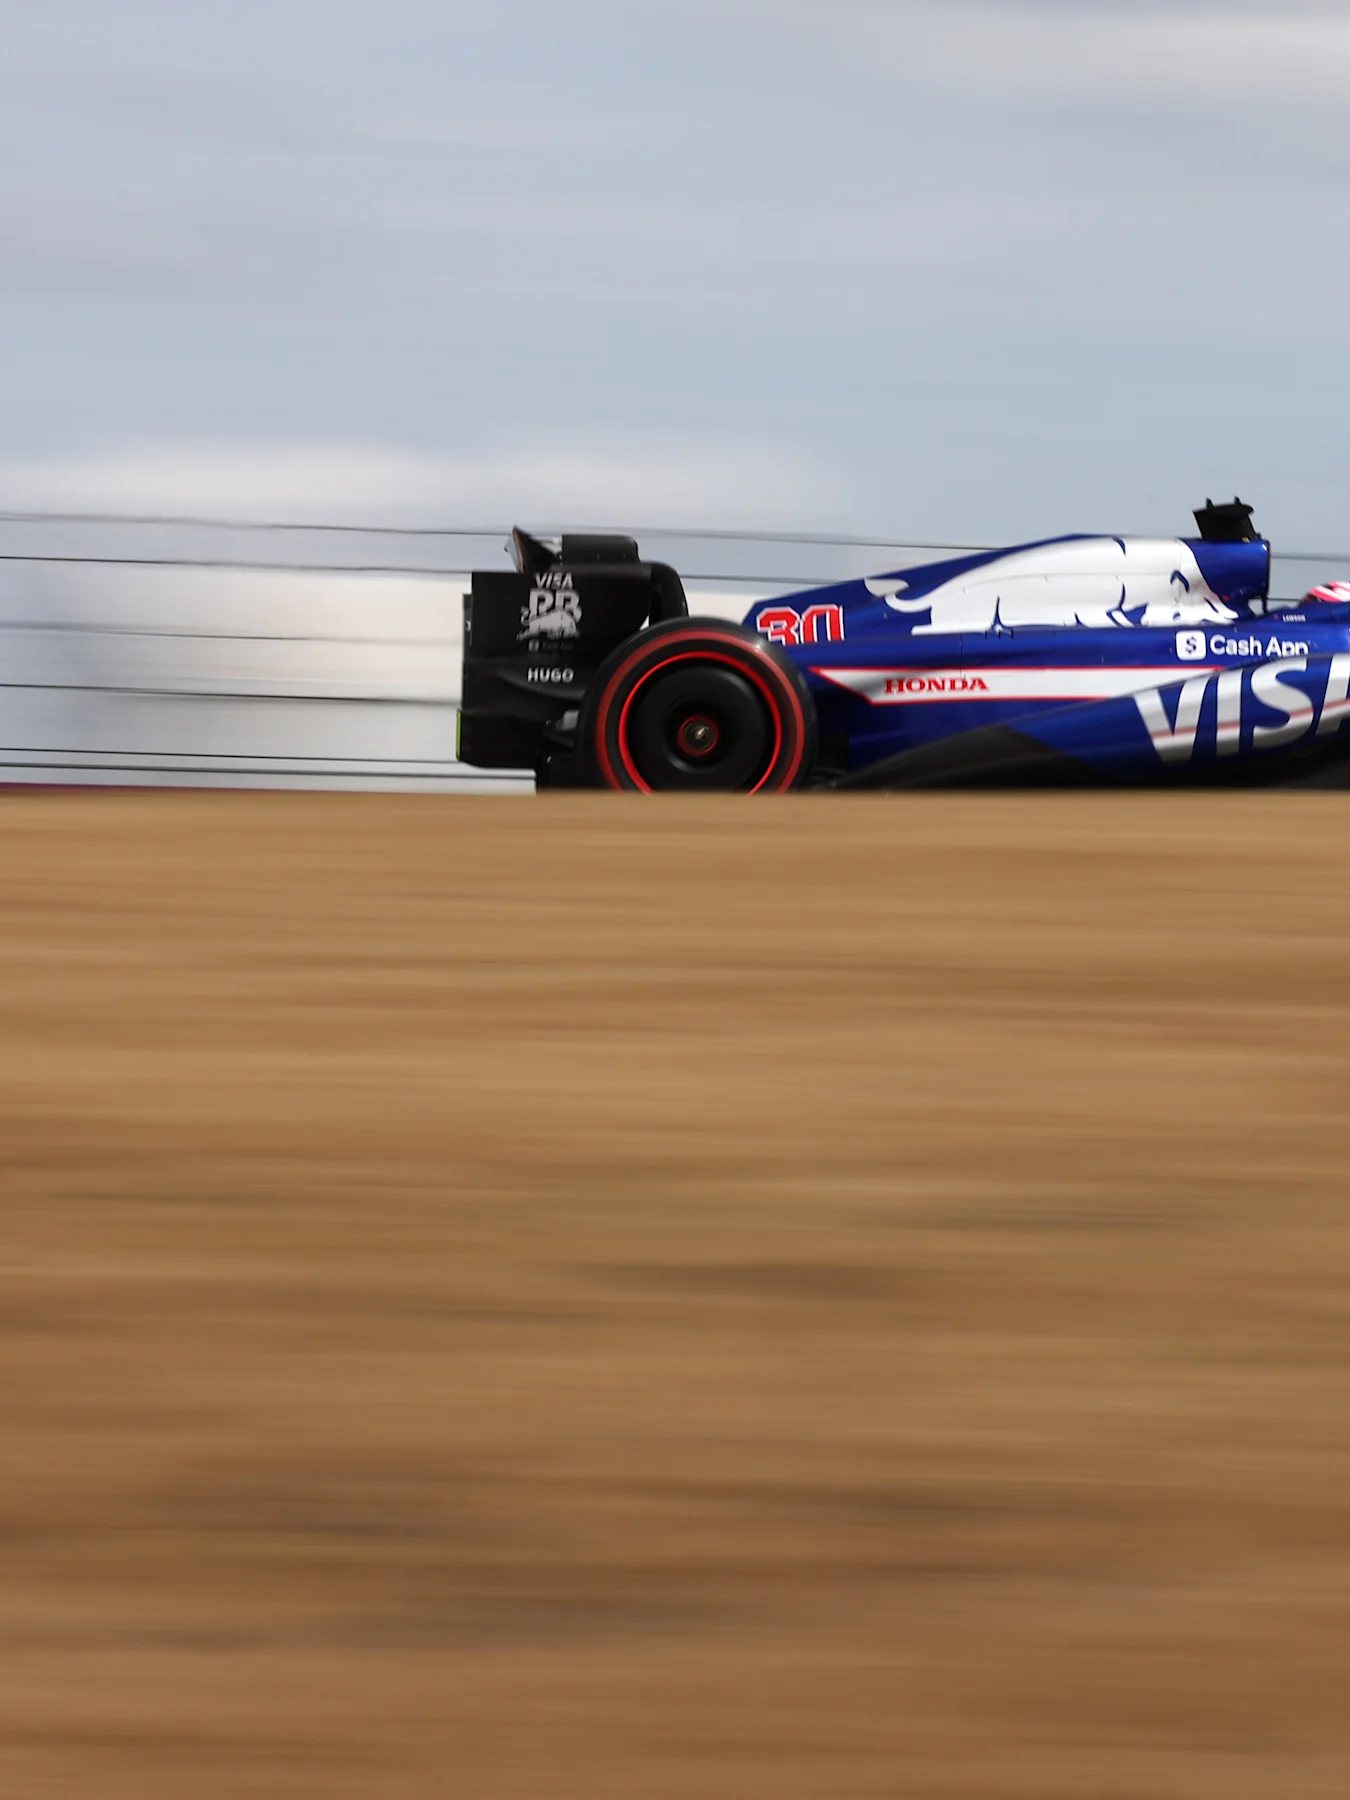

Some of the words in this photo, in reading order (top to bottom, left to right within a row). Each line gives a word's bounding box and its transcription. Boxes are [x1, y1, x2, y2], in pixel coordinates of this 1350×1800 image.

[535, 572, 574, 588] VISA
[756, 604, 845, 646] 30
[1210, 635, 1262, 656] Cash
[527, 667, 574, 683] HUGO
[884, 677, 989, 693] HONDA
